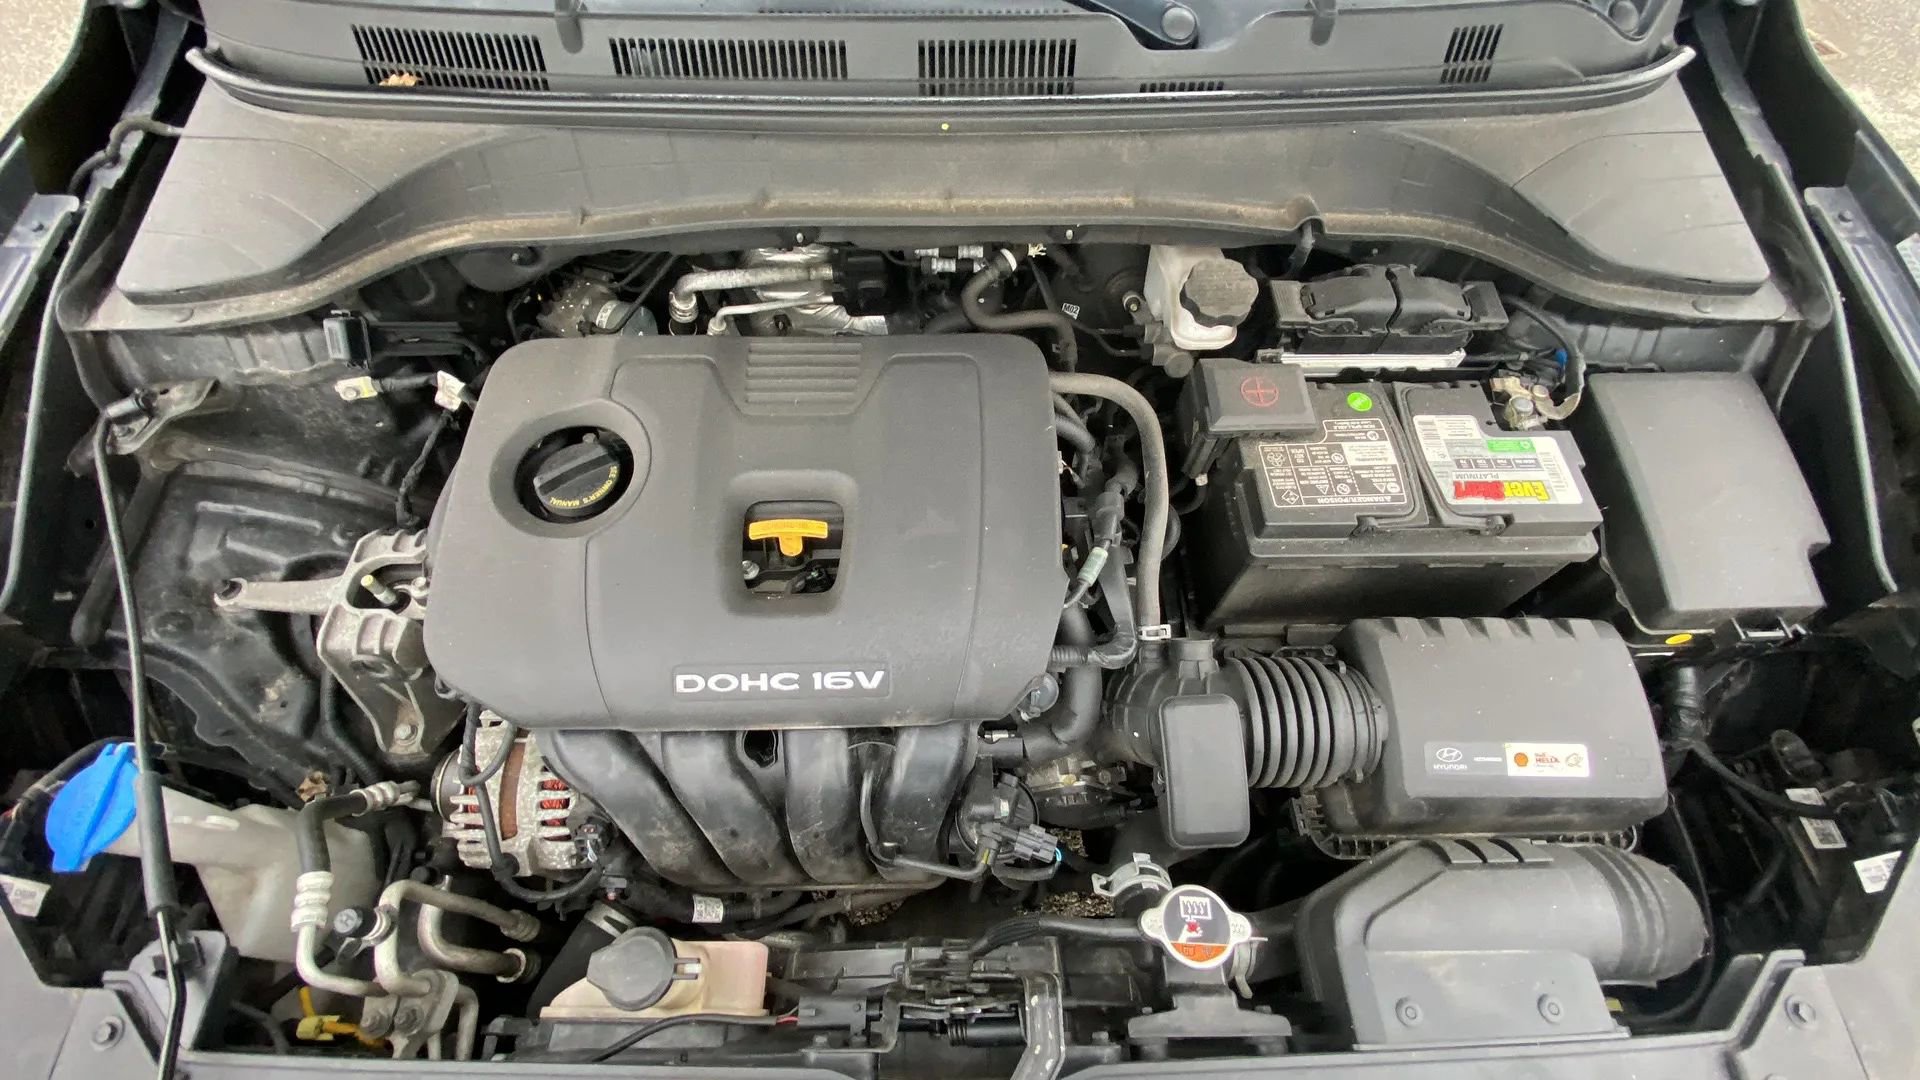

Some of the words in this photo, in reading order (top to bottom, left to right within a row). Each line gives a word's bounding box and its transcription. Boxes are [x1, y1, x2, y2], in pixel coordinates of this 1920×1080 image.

[608, 465, 618, 478] SEE
[1455, 472, 1500, 480] PLATINUM
[582, 479, 613, 504] OWNER'S
[549, 496, 580, 507] MANUAL
[675, 672, 801, 693] DOHC
[811, 670, 885, 690] 16V
[1433, 763, 1468, 771] HYUNDAI
